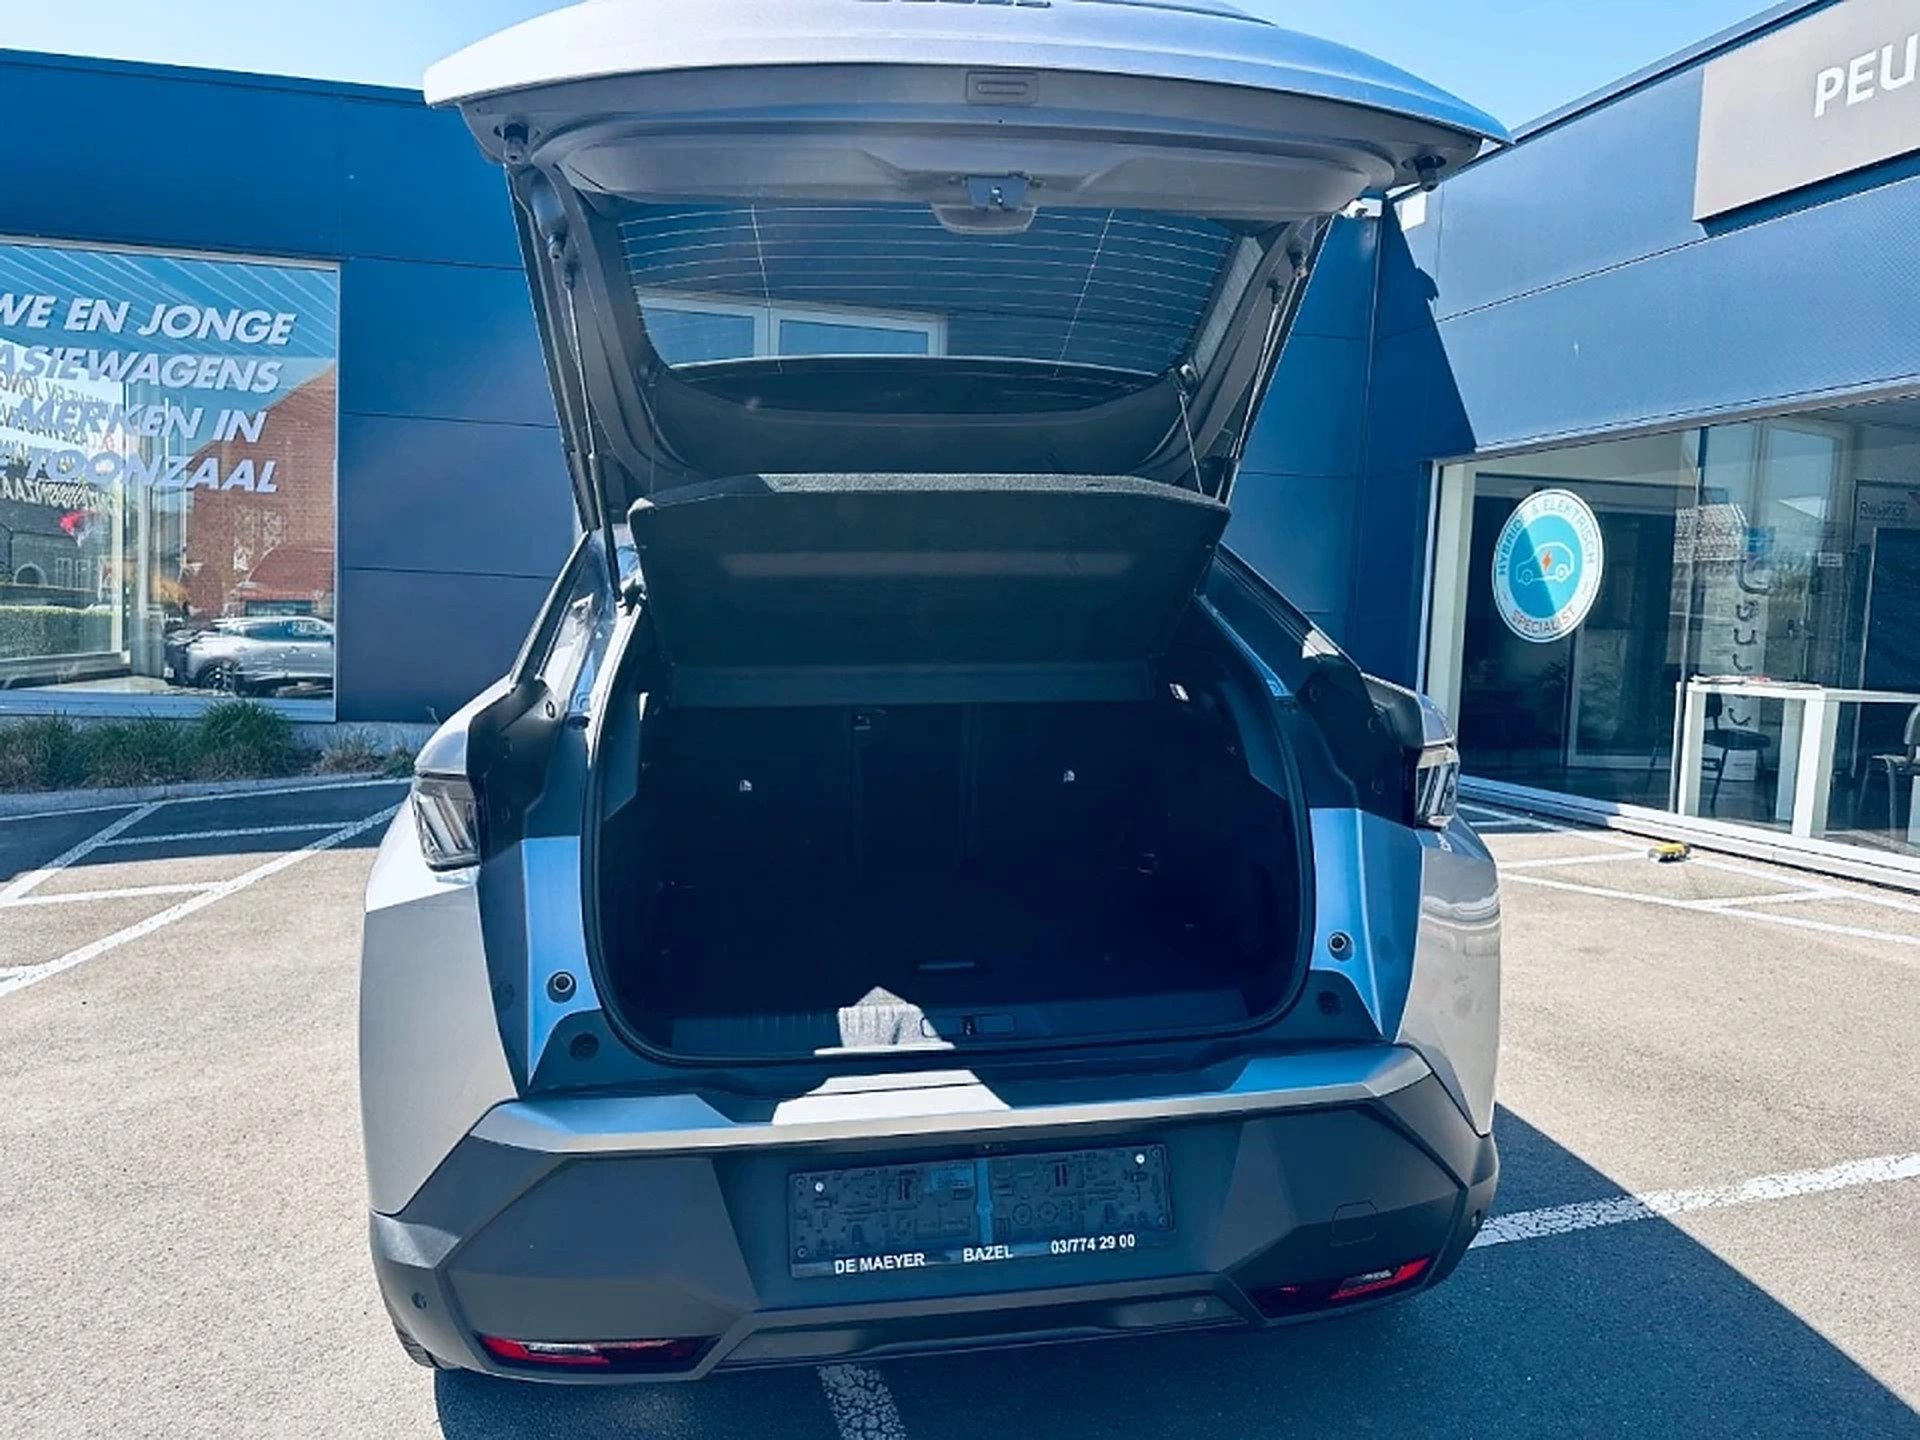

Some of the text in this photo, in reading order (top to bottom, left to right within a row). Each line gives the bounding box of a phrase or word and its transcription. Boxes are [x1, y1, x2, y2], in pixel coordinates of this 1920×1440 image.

[1814, 33, 1919, 119] PEU
[64, 297, 130, 333] EN
[137, 303, 297, 345] JONGE
[11, 398, 203, 439] MERKEN
[213, 409, 267, 443] IN
[26, 446, 277, 493] TOONZAAL
[1543, 499, 1595, 565] ELEKTRISCH
[1511, 605, 1576, 634] SPECIALIST
[834, 1233, 1136, 1275] DE MAEYER BAZEL 03/774 29 00
